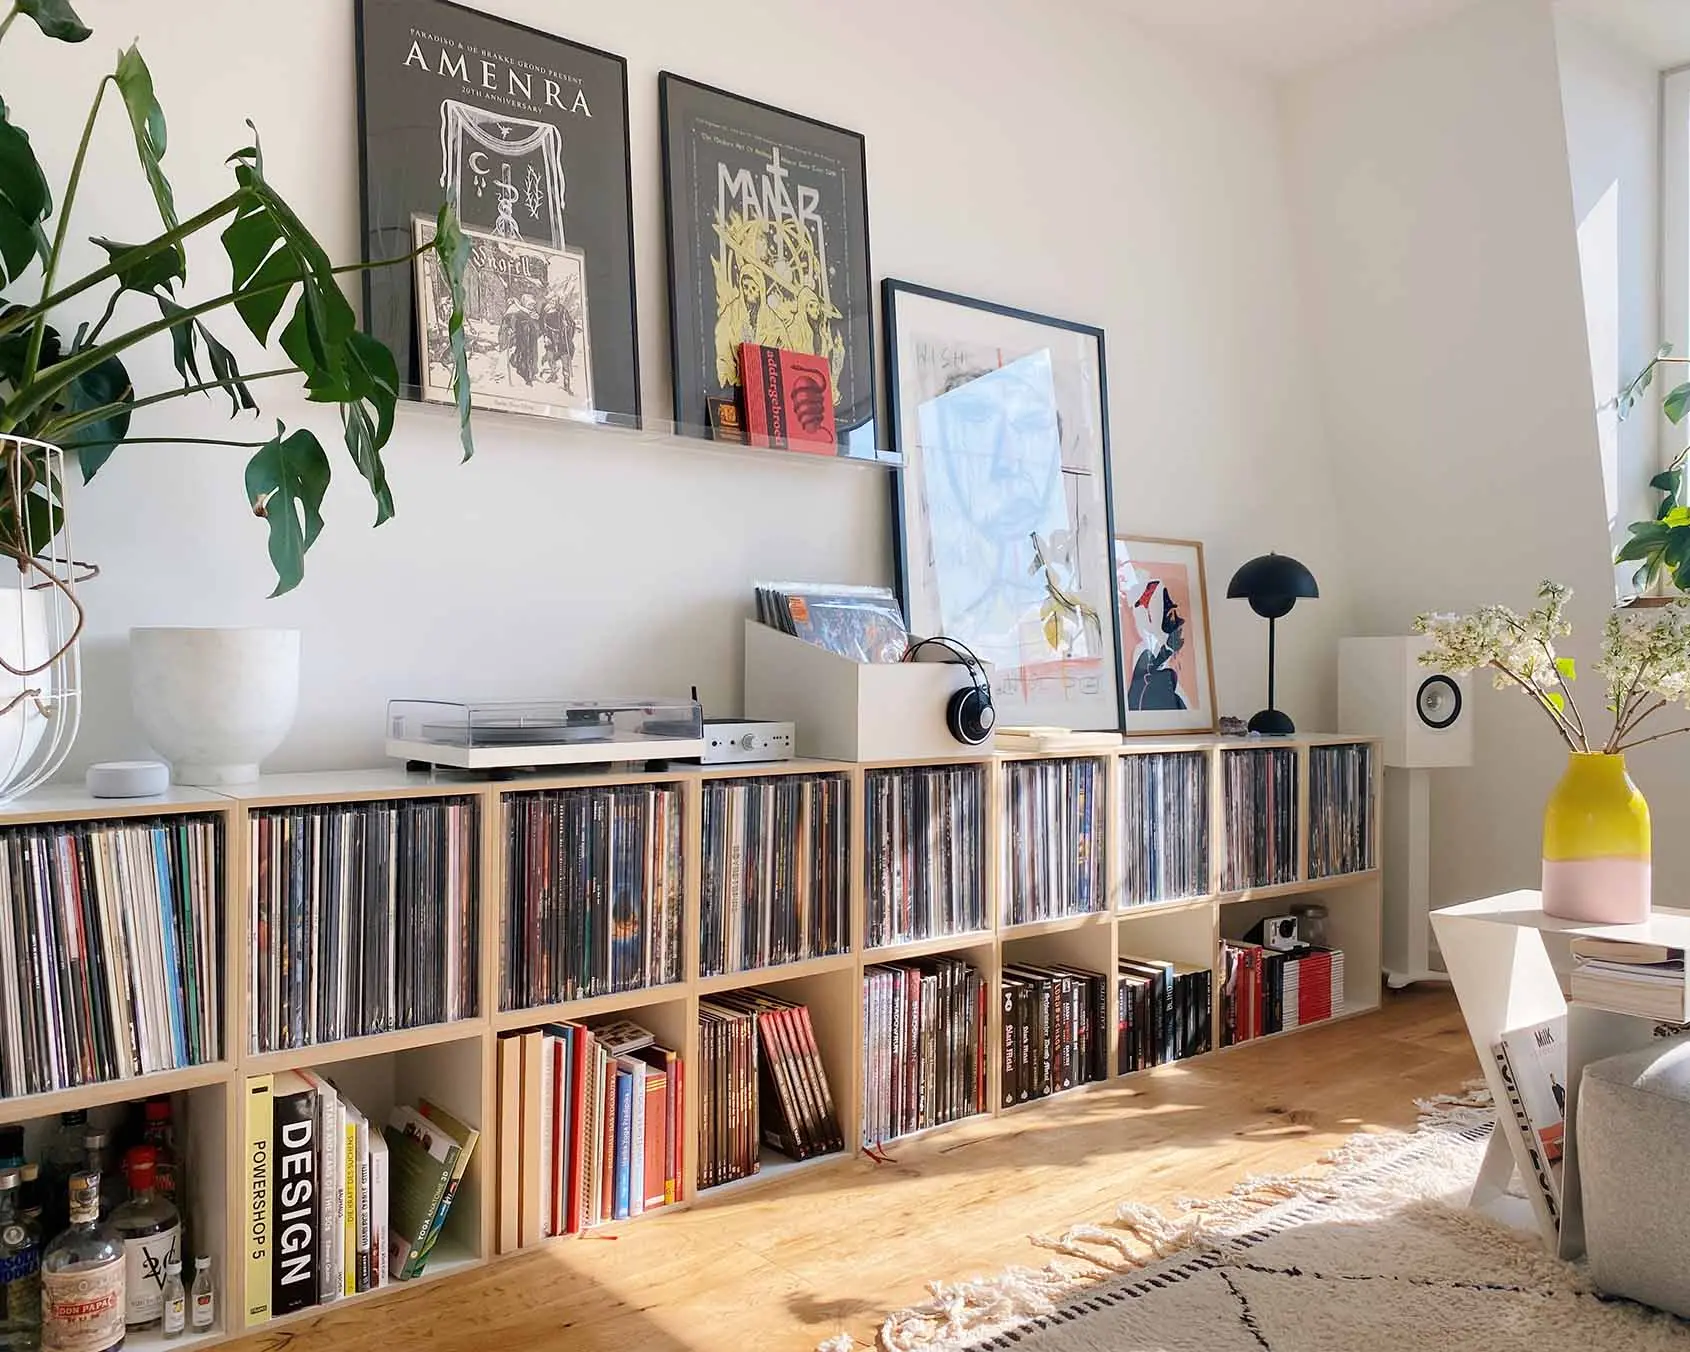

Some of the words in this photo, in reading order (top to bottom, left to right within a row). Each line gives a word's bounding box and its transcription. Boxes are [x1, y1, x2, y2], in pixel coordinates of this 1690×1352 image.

[402, 39, 593, 118] AMENRA
[461, 86, 483, 98] 20TH
[484, 92, 543, 114] ANNIVERSARY
[1005, 1025, 1014, 1047] Black
[1005, 1049, 1014, 1072] Metal
[252, 1141, 267, 1245] POWERSHOP
[280, 1119, 313, 1286] DESIGN
[252, 1250, 265, 1259] 5
[60, 1307, 80, 1315] DON
[82, 1300, 108, 1313] PAPA
